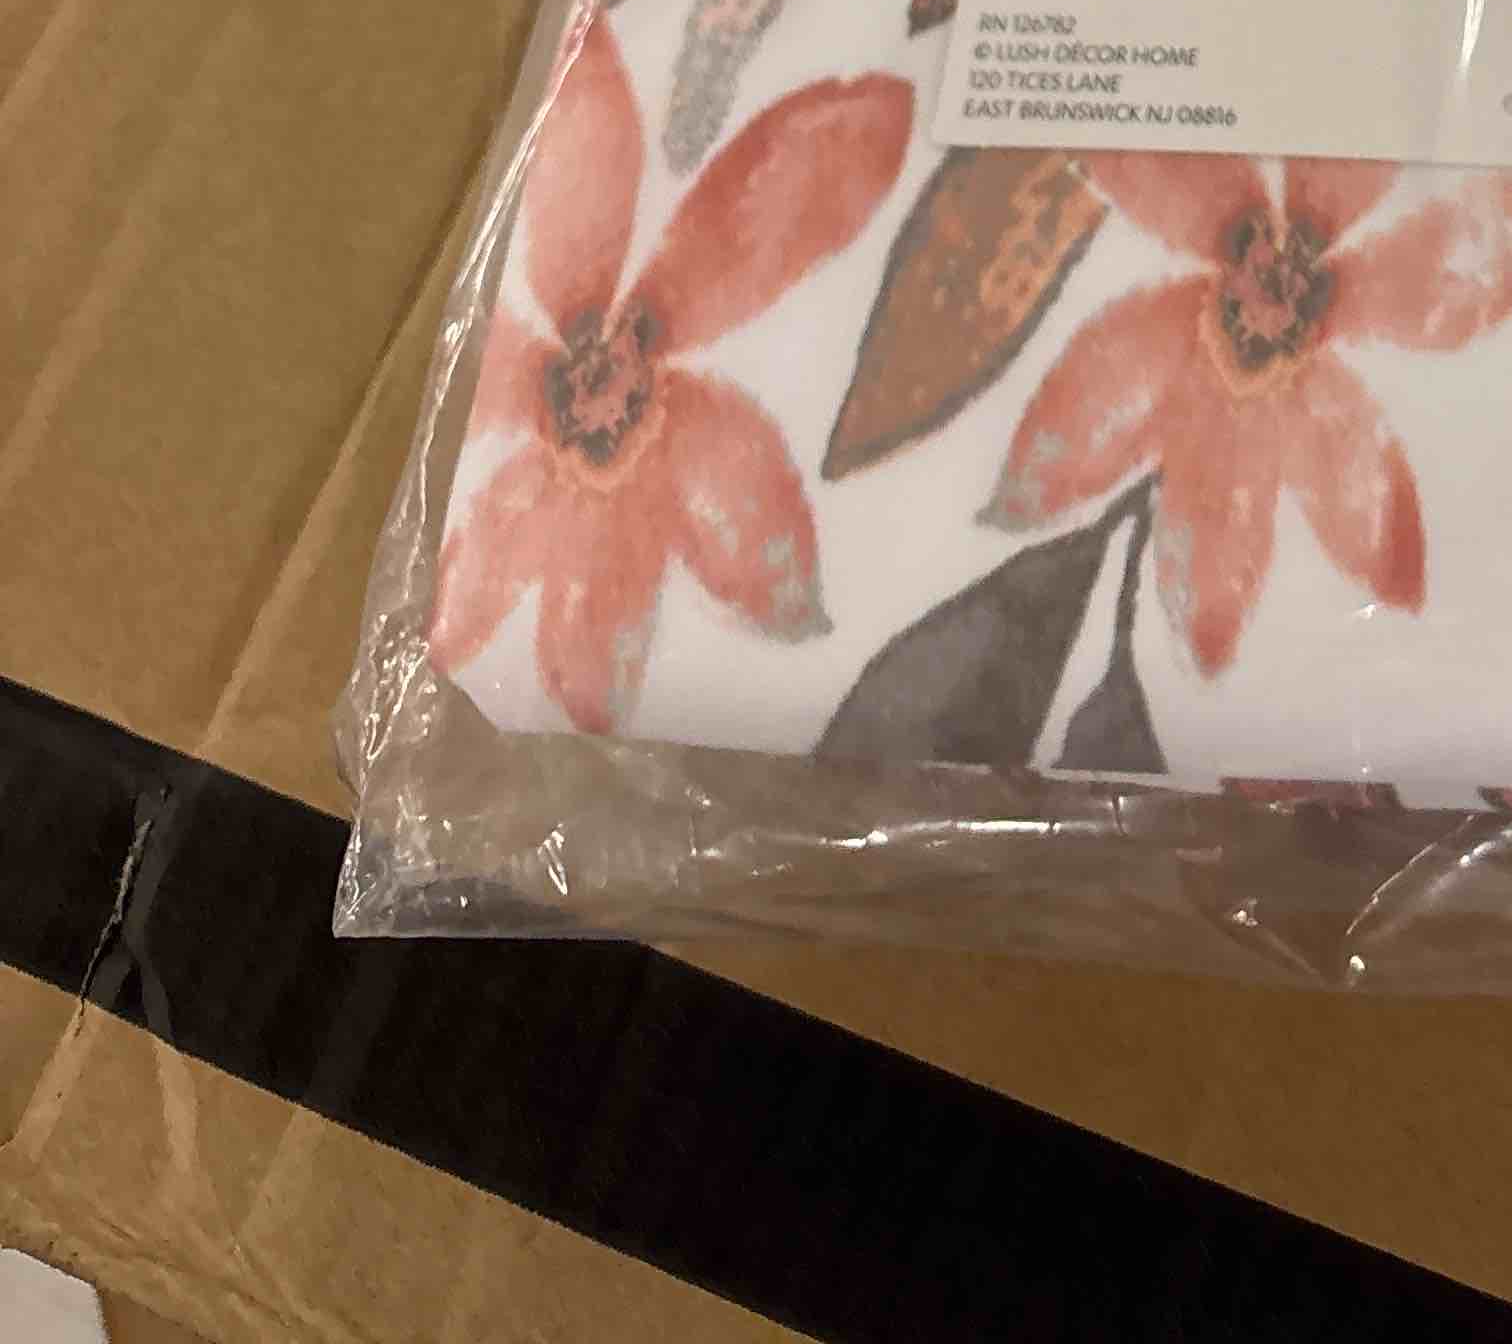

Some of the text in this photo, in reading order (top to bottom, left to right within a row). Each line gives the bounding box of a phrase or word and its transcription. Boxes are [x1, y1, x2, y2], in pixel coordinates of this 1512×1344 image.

[978, 13, 1007, 33] RN
[998, 43, 1050, 62] LUSH
[1131, 46, 1199, 67] HOME
[969, 70, 1124, 94] 120 TICES LANE
[964, 98, 1016, 119] EAST
[1020, 100, 1141, 124] BRUNSWICK
[1147, 105, 1175, 126] NJ
